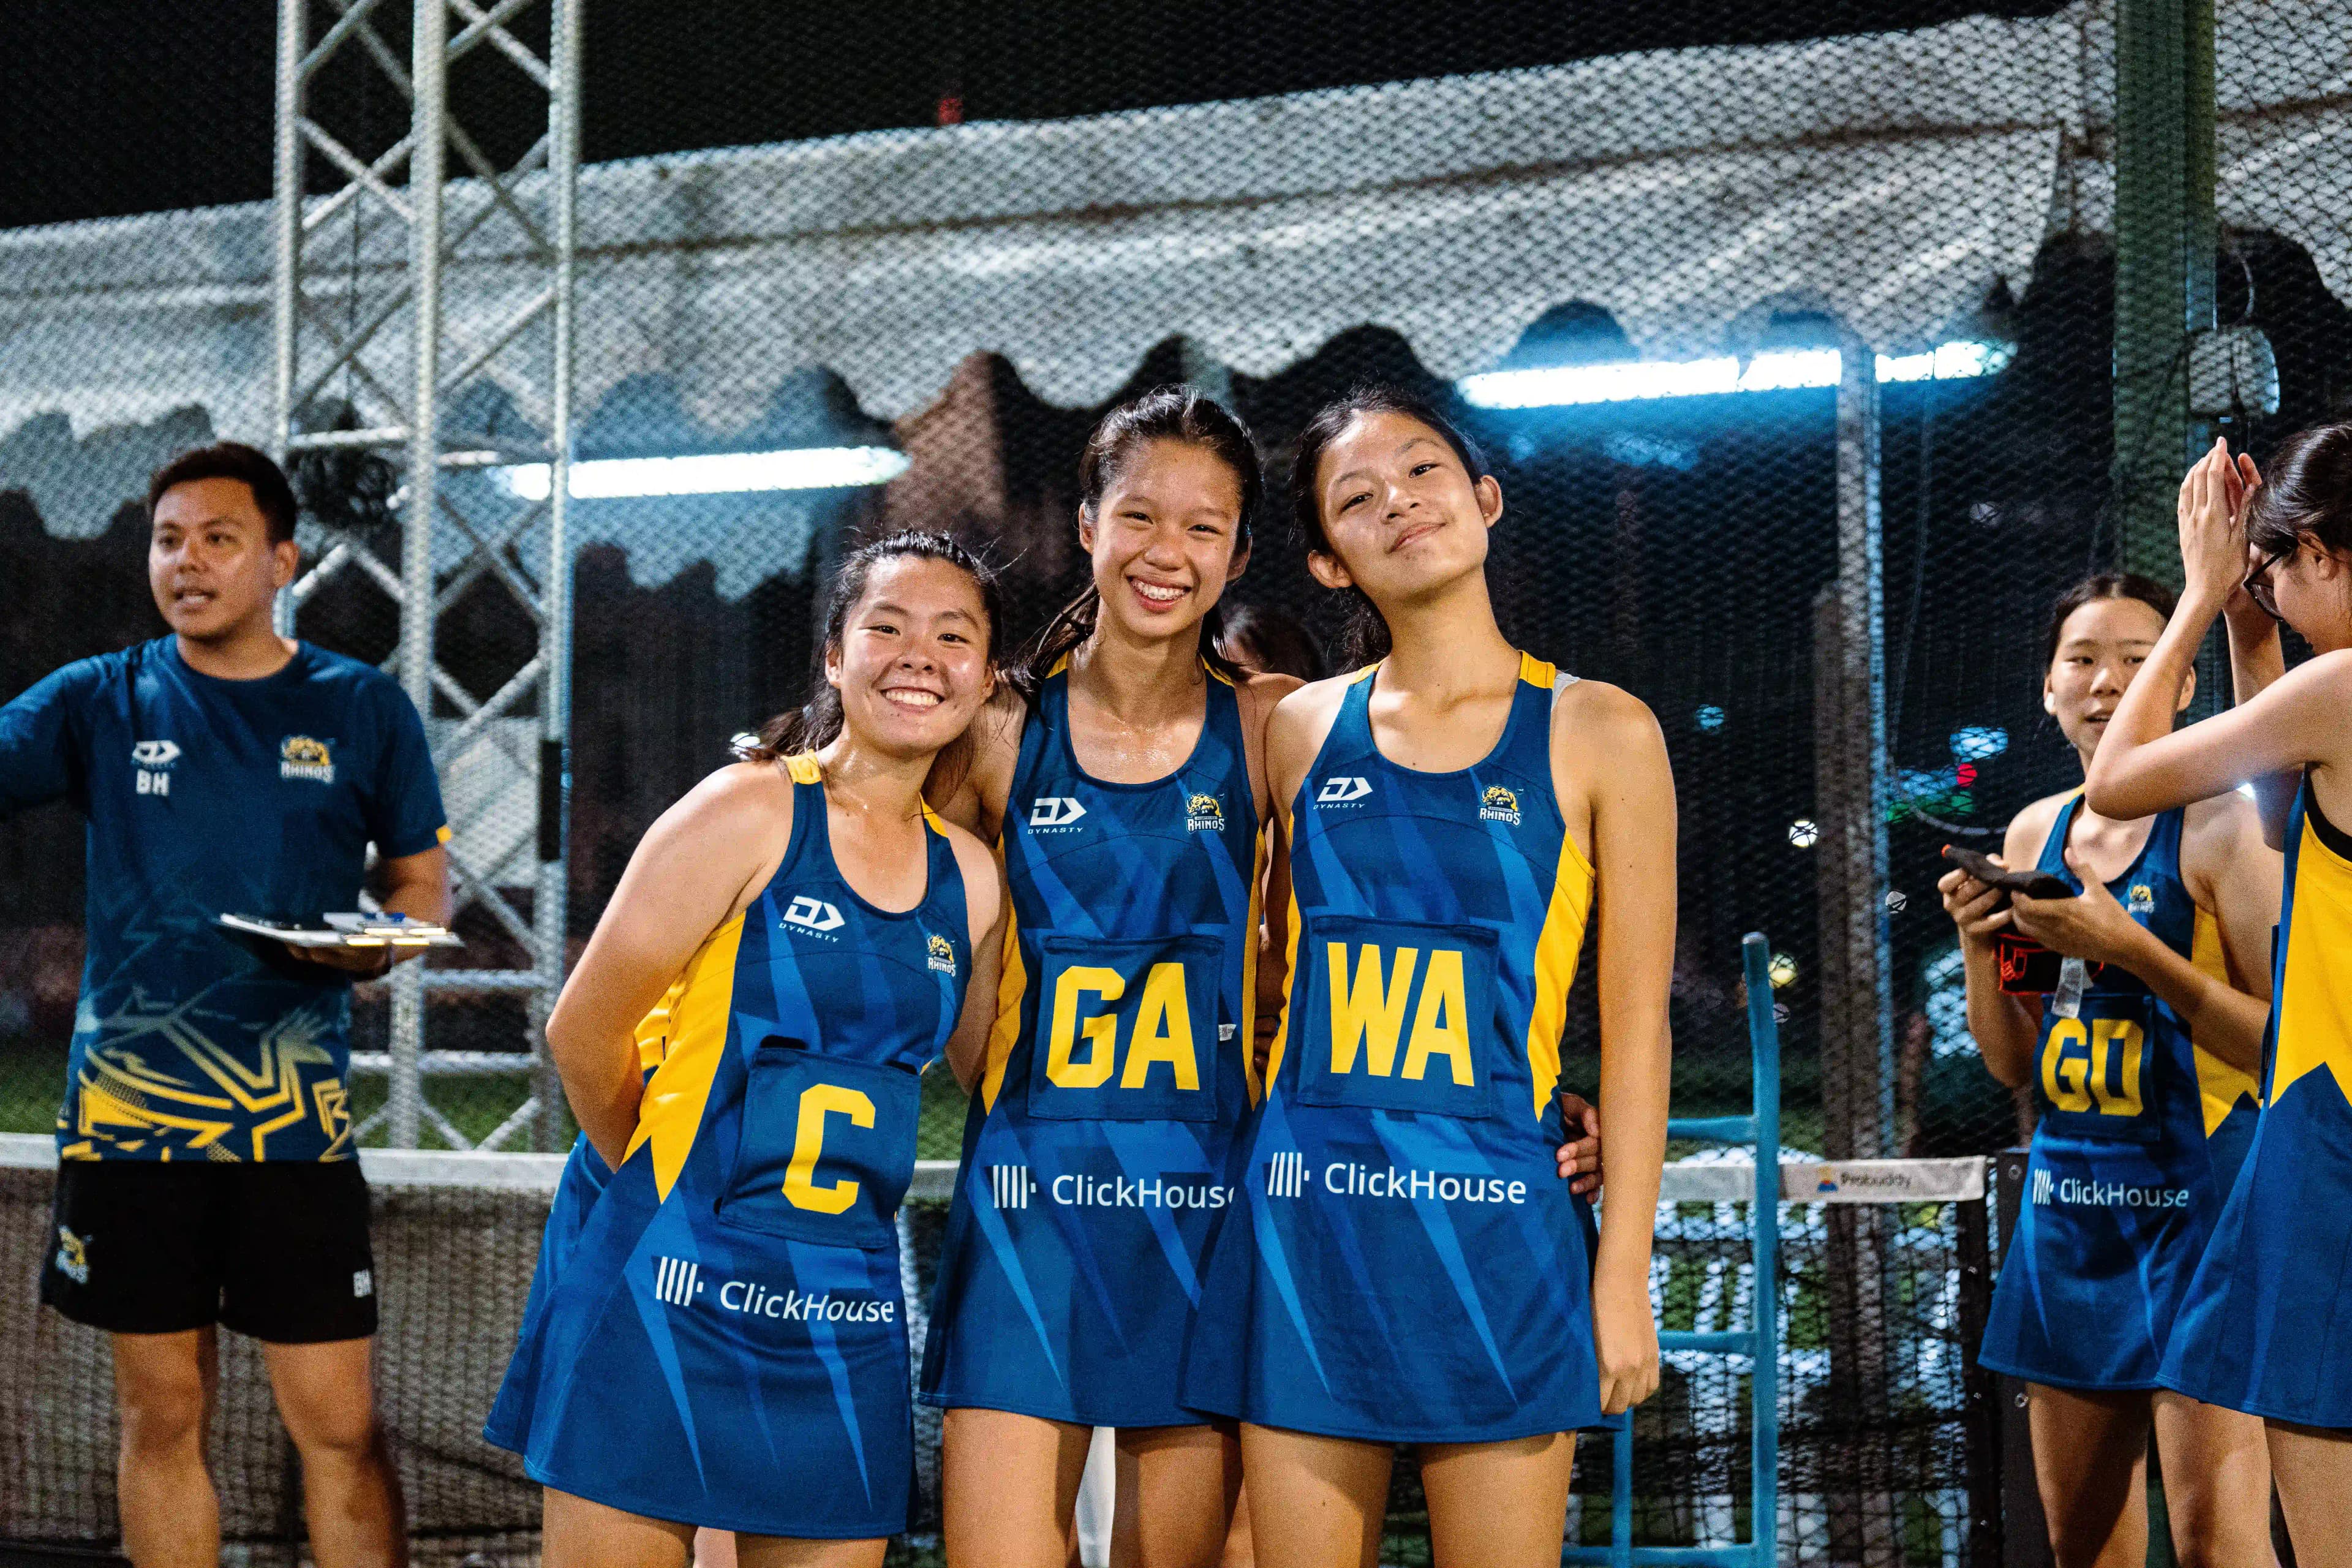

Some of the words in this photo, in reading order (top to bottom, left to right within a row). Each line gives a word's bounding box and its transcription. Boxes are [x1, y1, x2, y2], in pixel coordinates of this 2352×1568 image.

[1187, 818, 1225, 832] RHINOS
[1479, 807, 1521, 826] RHINOS
[778, 922, 840, 943] DYNASTY
[928, 957, 956, 978] RHINOS
[1046, 962, 1200, 1090] GA
[1327, 941, 1475, 1087] WA
[2041, 1017, 2144, 1117] GD
[782, 1083, 876, 1215] C
[1325, 1163, 1526, 1204] ClickHouse
[2060, 1178, 2190, 1207] ClickHouse
[720, 1281, 894, 1322] ClickHouse
